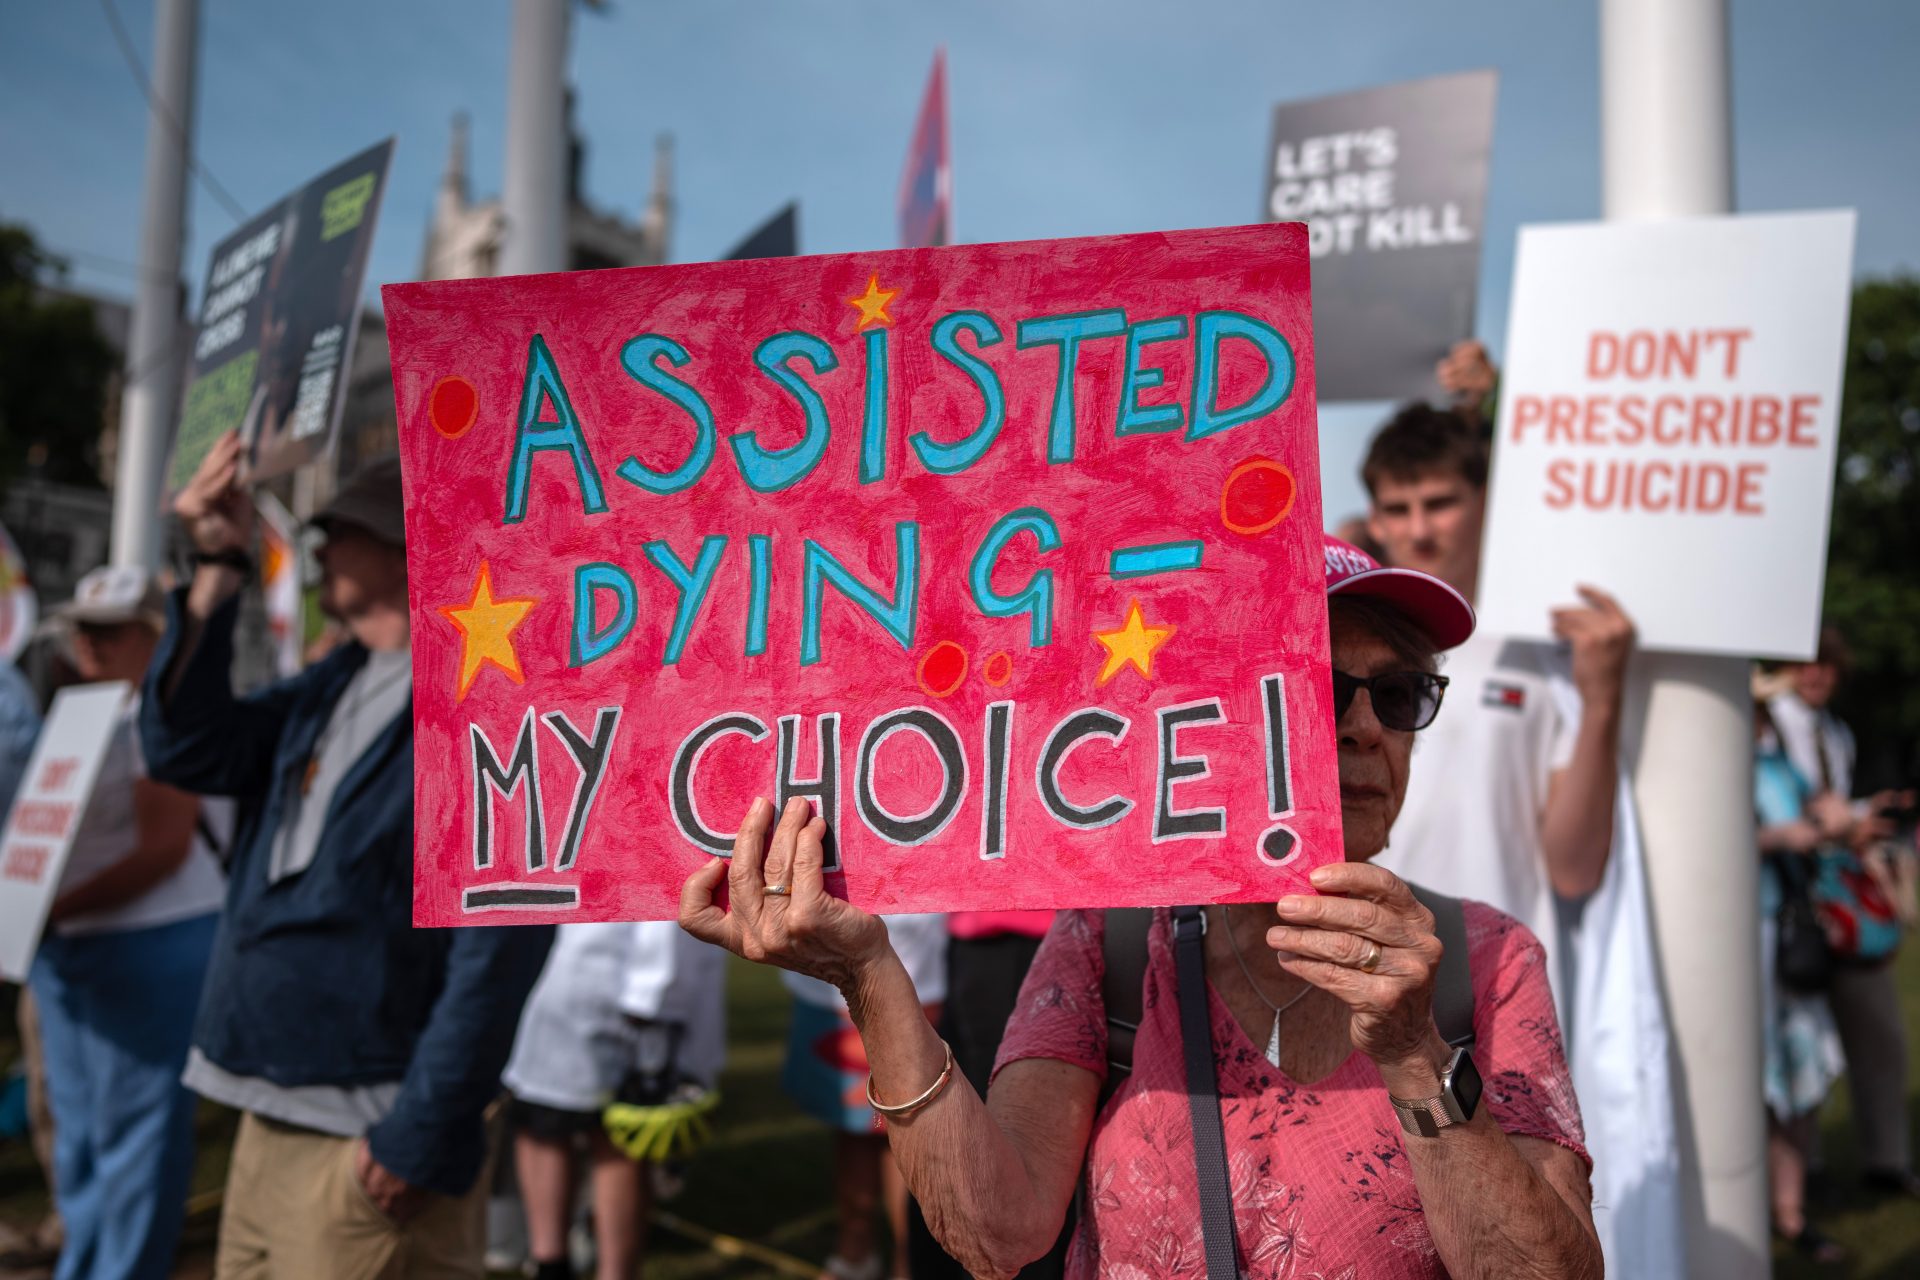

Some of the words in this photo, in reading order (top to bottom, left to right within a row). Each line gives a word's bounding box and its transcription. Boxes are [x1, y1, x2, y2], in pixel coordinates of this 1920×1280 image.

[1275, 126, 1397, 178] LET'S
[1270, 169, 1396, 220] CARE
[1307, 214, 1361, 257] OT
[1366, 203, 1474, 250] KILL
[1585, 327, 1753, 382] DON'T
[502, 307, 1296, 524] ASSISTED
[1510, 393, 1823, 448] PRESCRIBE
[1543, 458, 1769, 516] SUICIDE
[469, 705, 623, 873] MY
[669, 673, 1302, 873] CHOICE!
